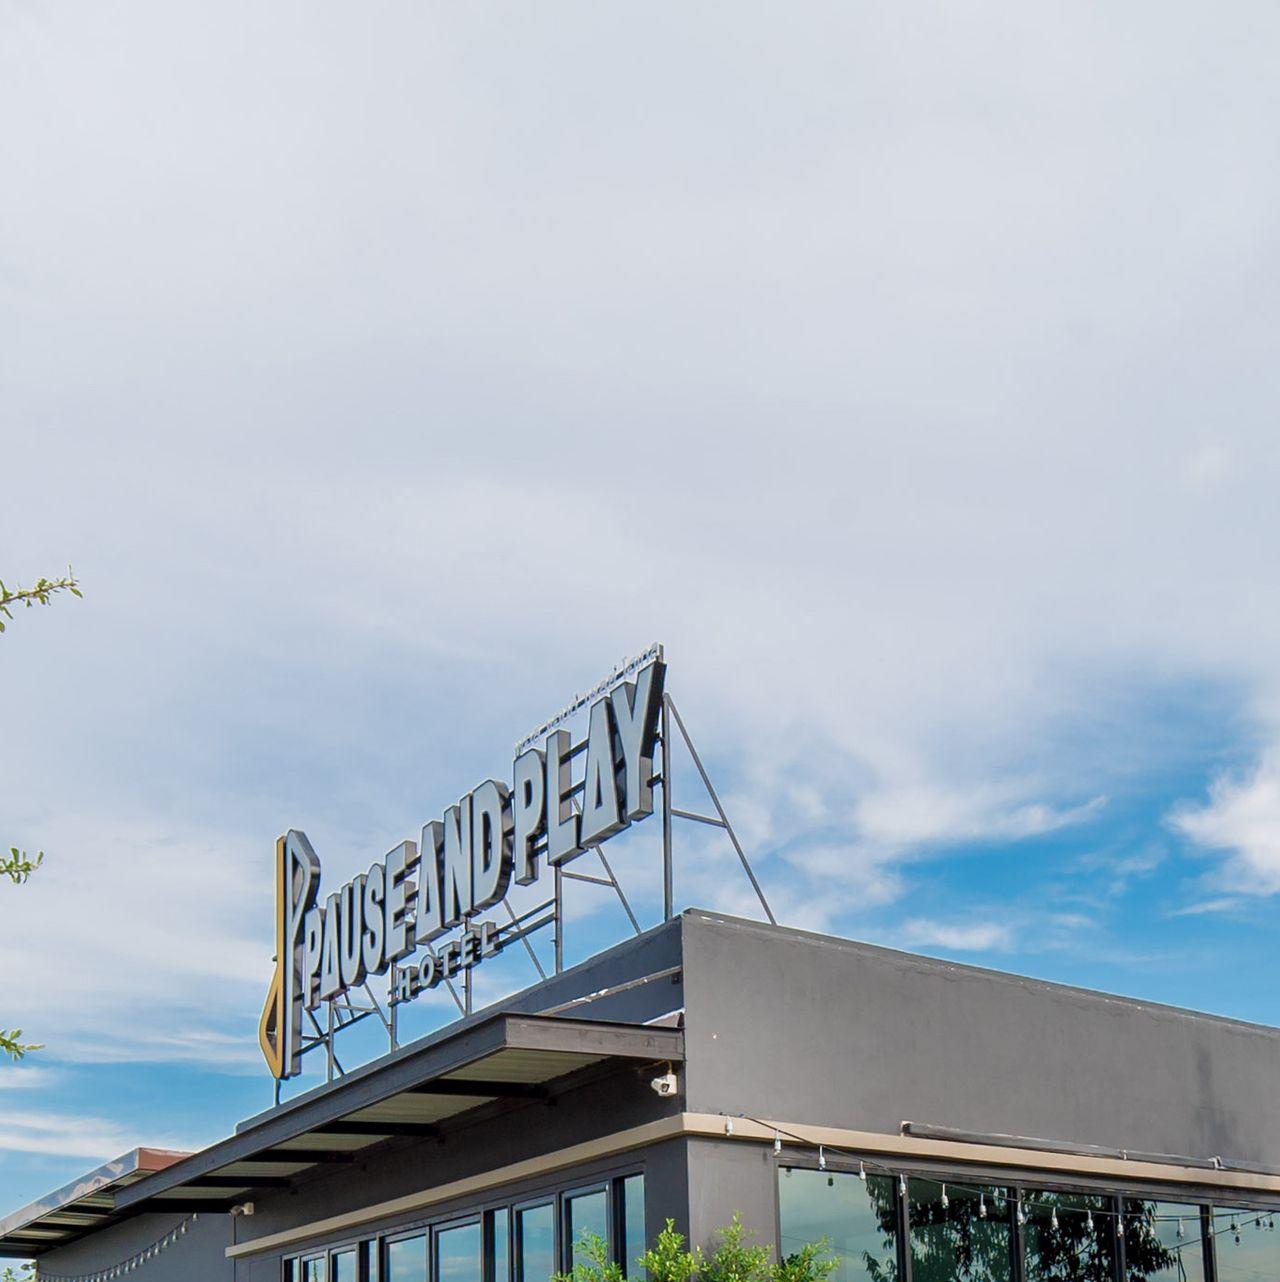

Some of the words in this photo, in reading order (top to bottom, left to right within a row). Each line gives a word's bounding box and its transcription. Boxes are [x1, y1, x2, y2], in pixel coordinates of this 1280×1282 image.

[304, 840, 417, 1011] PAUSE
[416, 779, 514, 946] AND
[514, 661, 667, 886] PLAY
[395, 921, 503, 1001] HOTEL
